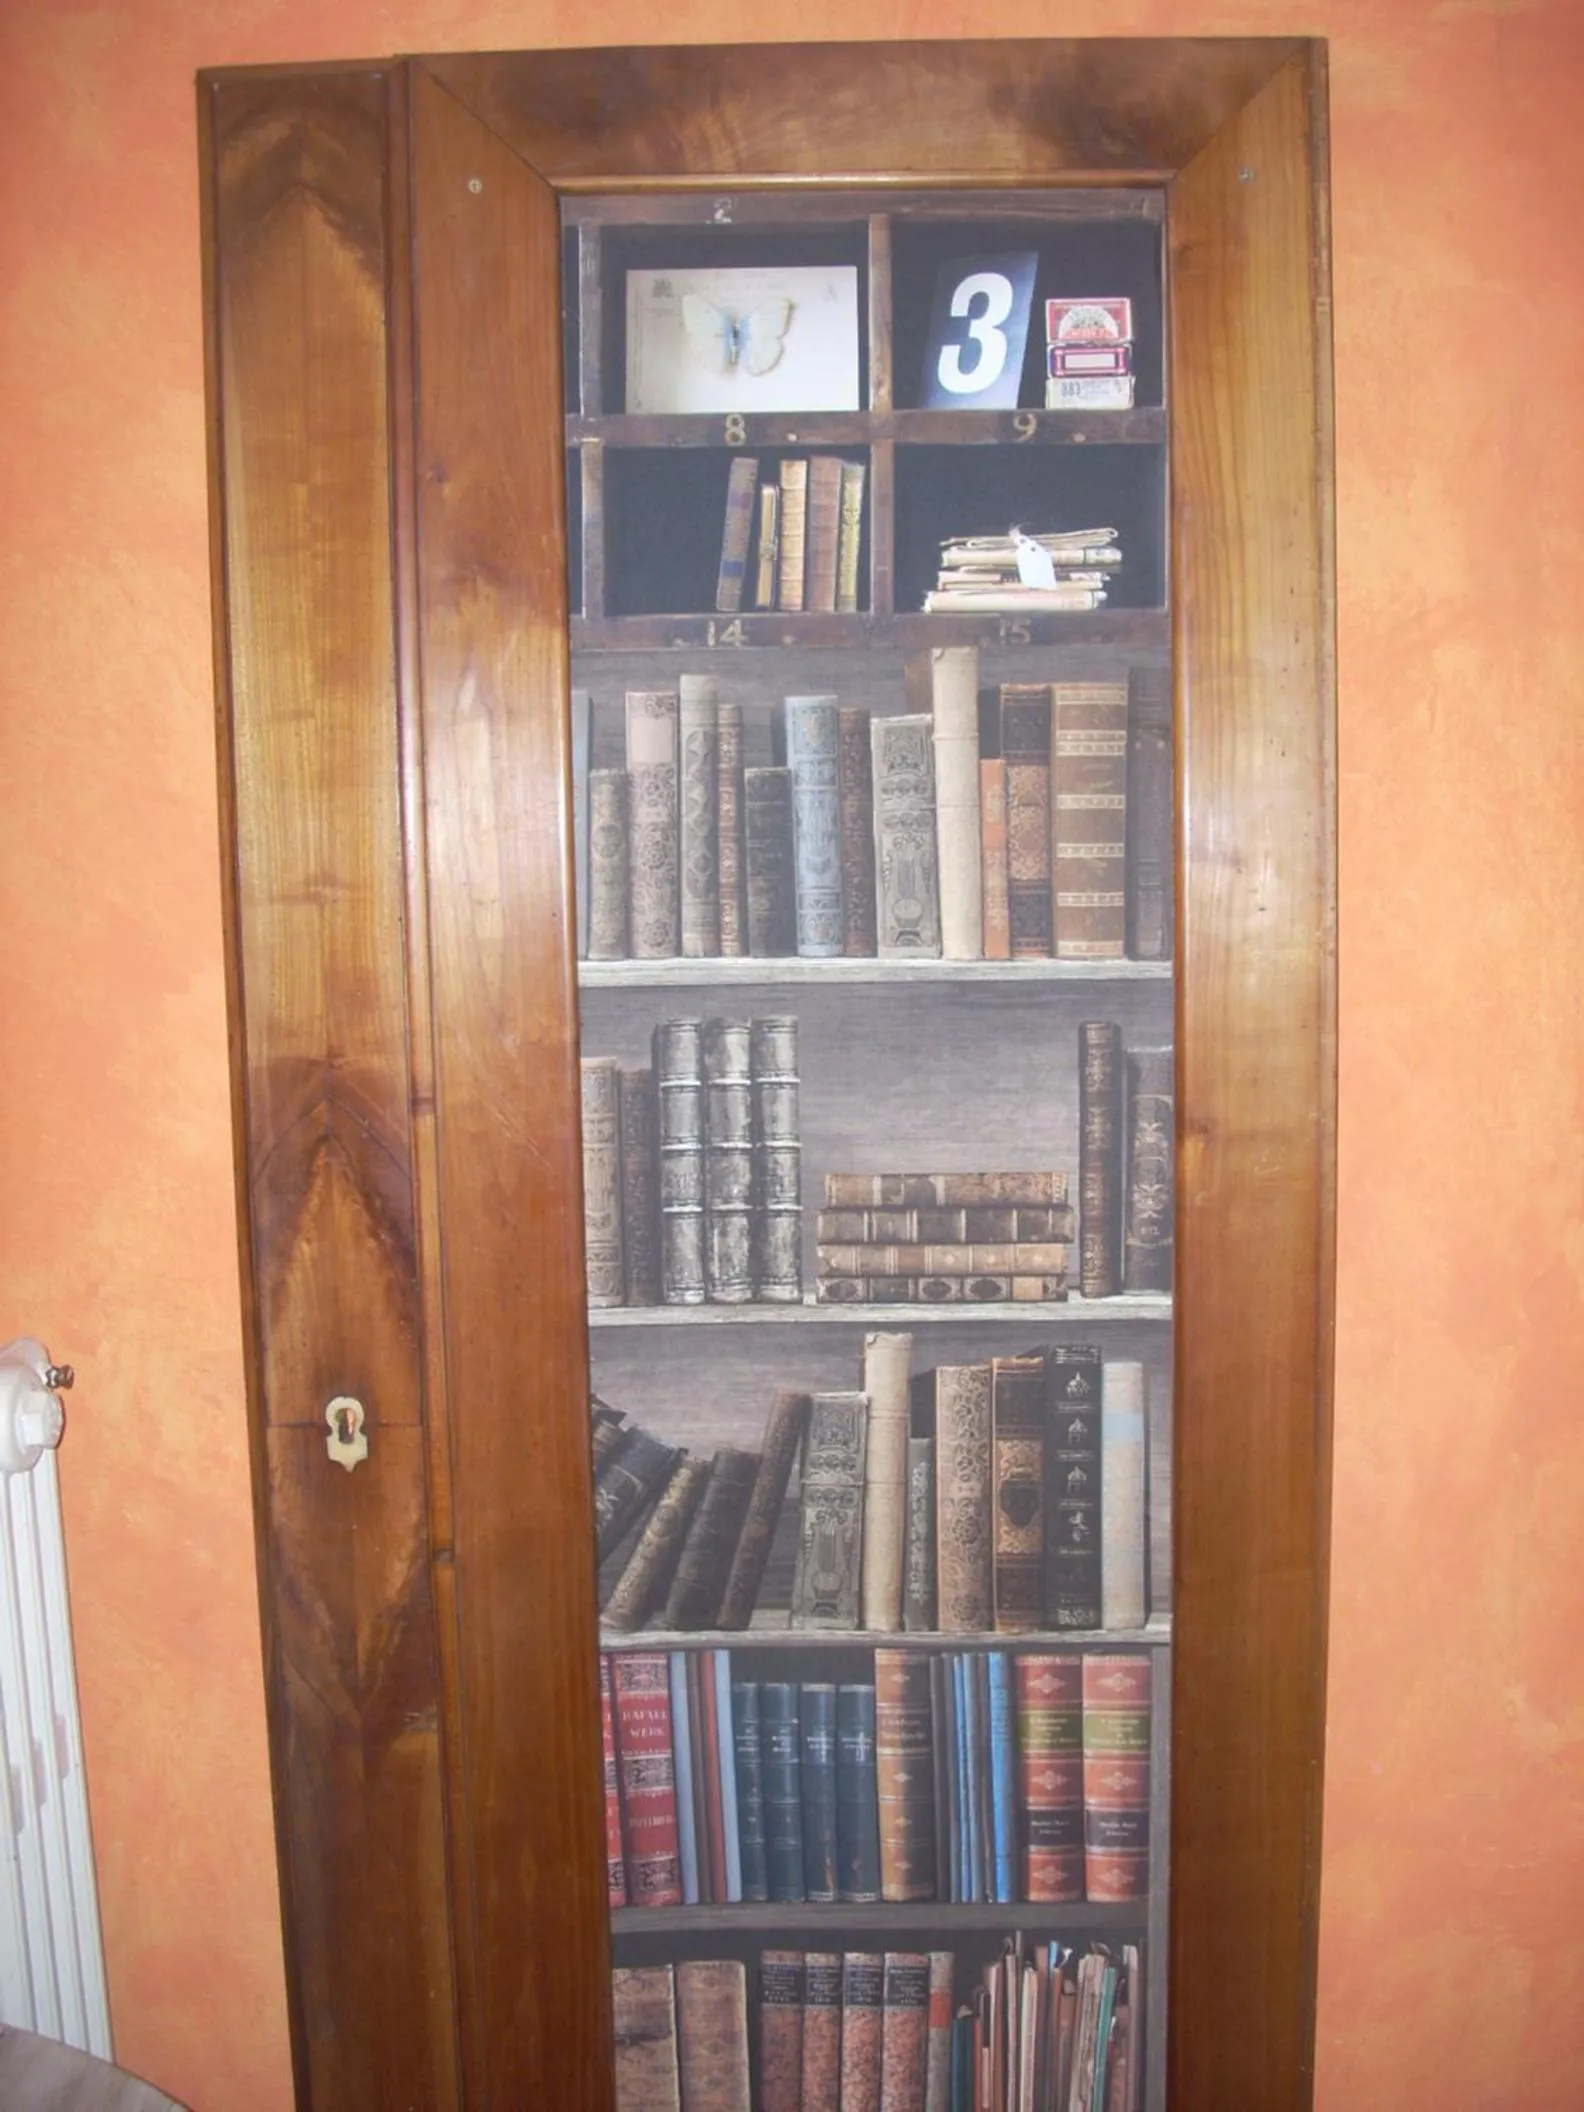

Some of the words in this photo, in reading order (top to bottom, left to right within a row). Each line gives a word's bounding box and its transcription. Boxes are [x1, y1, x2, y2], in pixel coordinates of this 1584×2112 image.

[714, 197, 732, 224] 2
[938, 272, 1013, 394] 3
[724, 413, 746, 447] 8
[1013, 412, 1036, 443] 9
[707, 619, 748, 648] 14
[1000, 618, 1031, 646] 15
